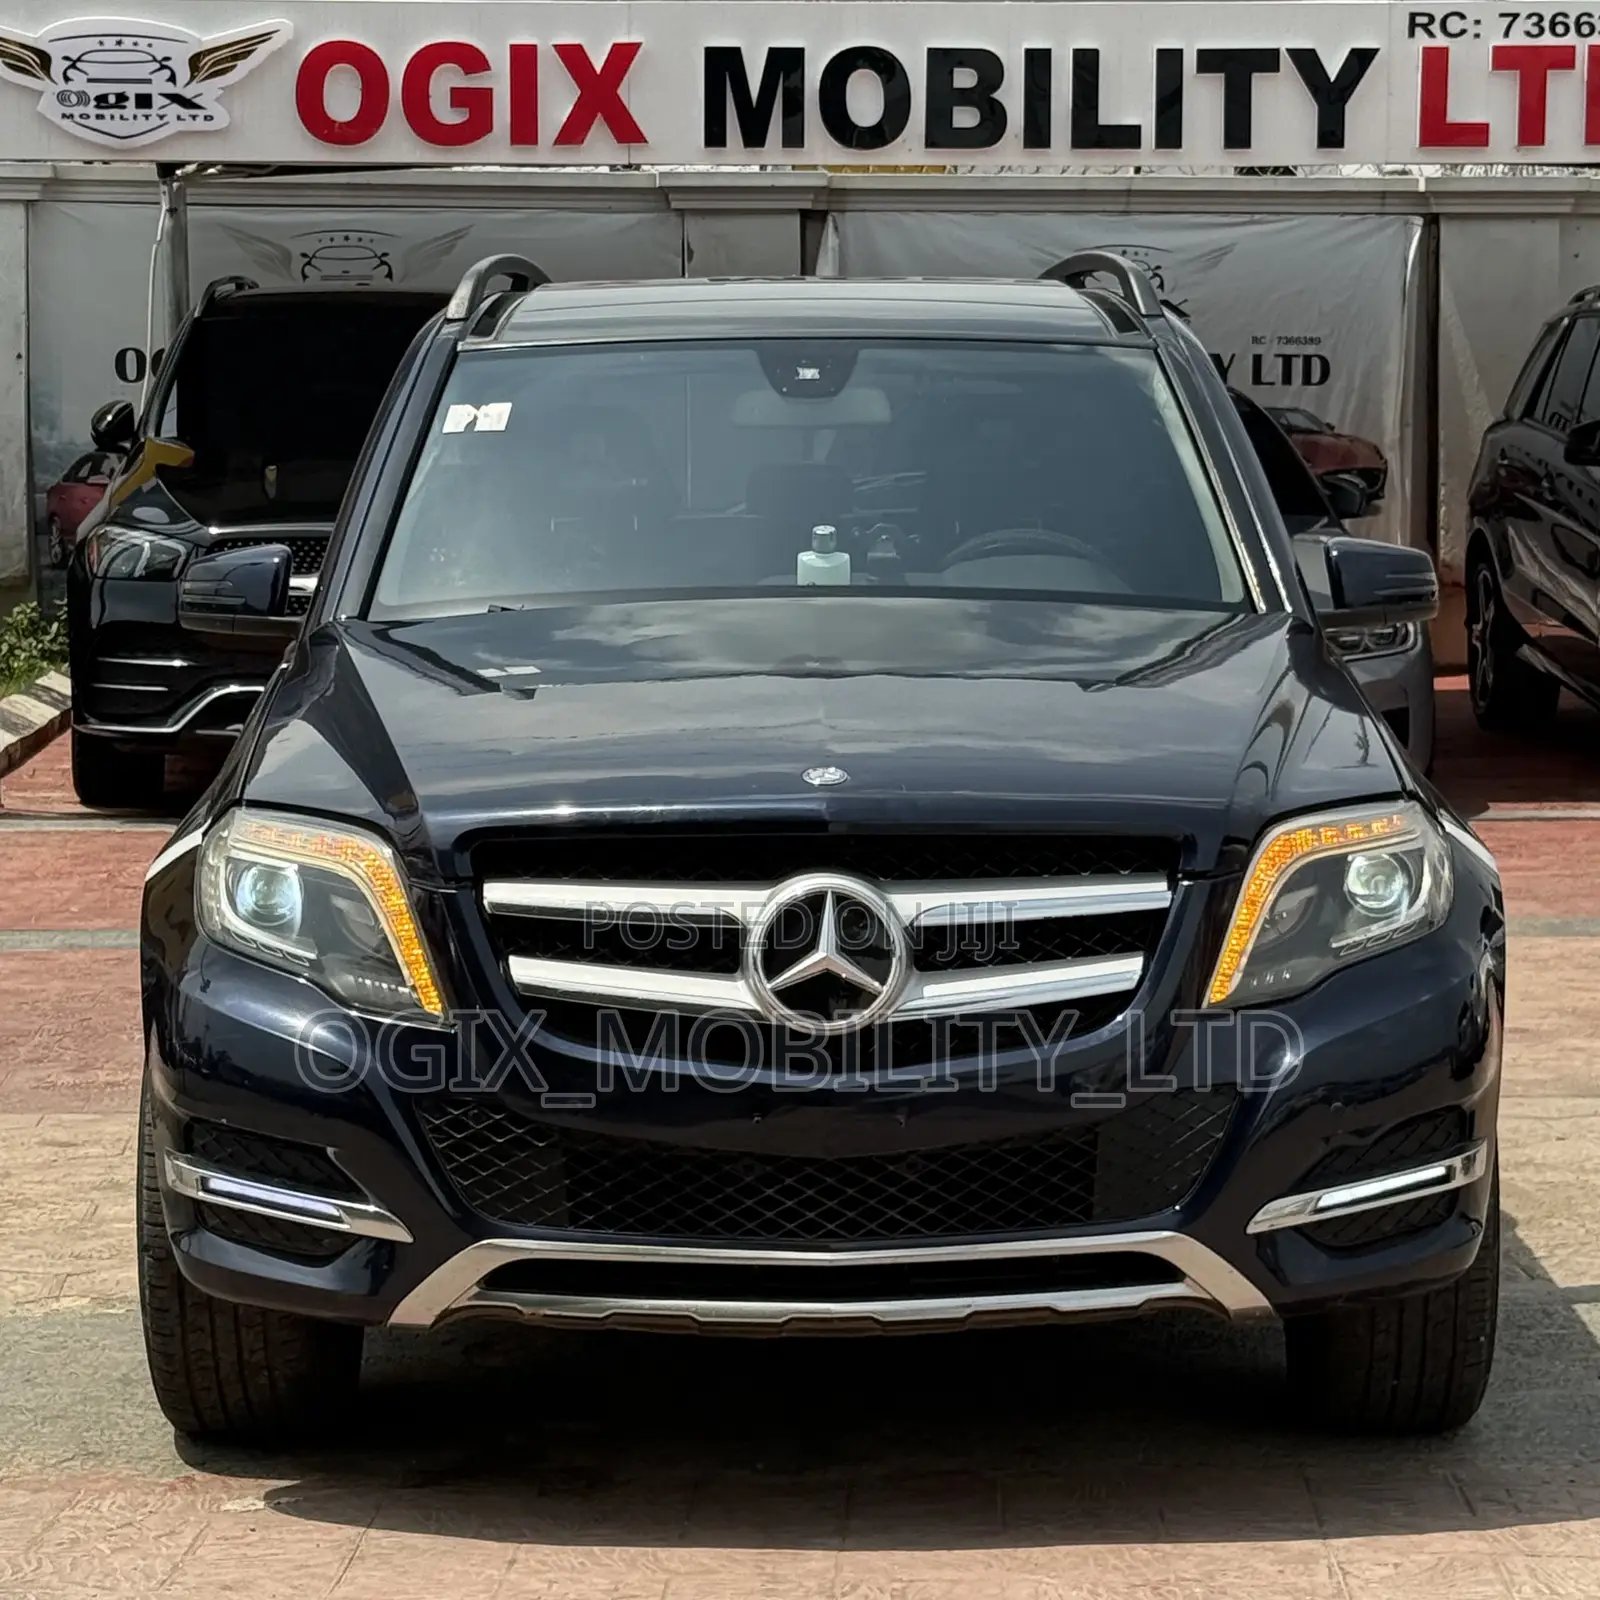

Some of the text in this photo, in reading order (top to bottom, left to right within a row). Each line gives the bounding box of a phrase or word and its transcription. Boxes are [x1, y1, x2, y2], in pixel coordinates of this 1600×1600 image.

[1407, 11, 1600, 39] RC: 7366
[295, 39, 1600, 151] OGIX MOBILITY LT
[61, 112, 214, 122] MOBILITY LTD
[1252, 354, 1331, 386] LTD
